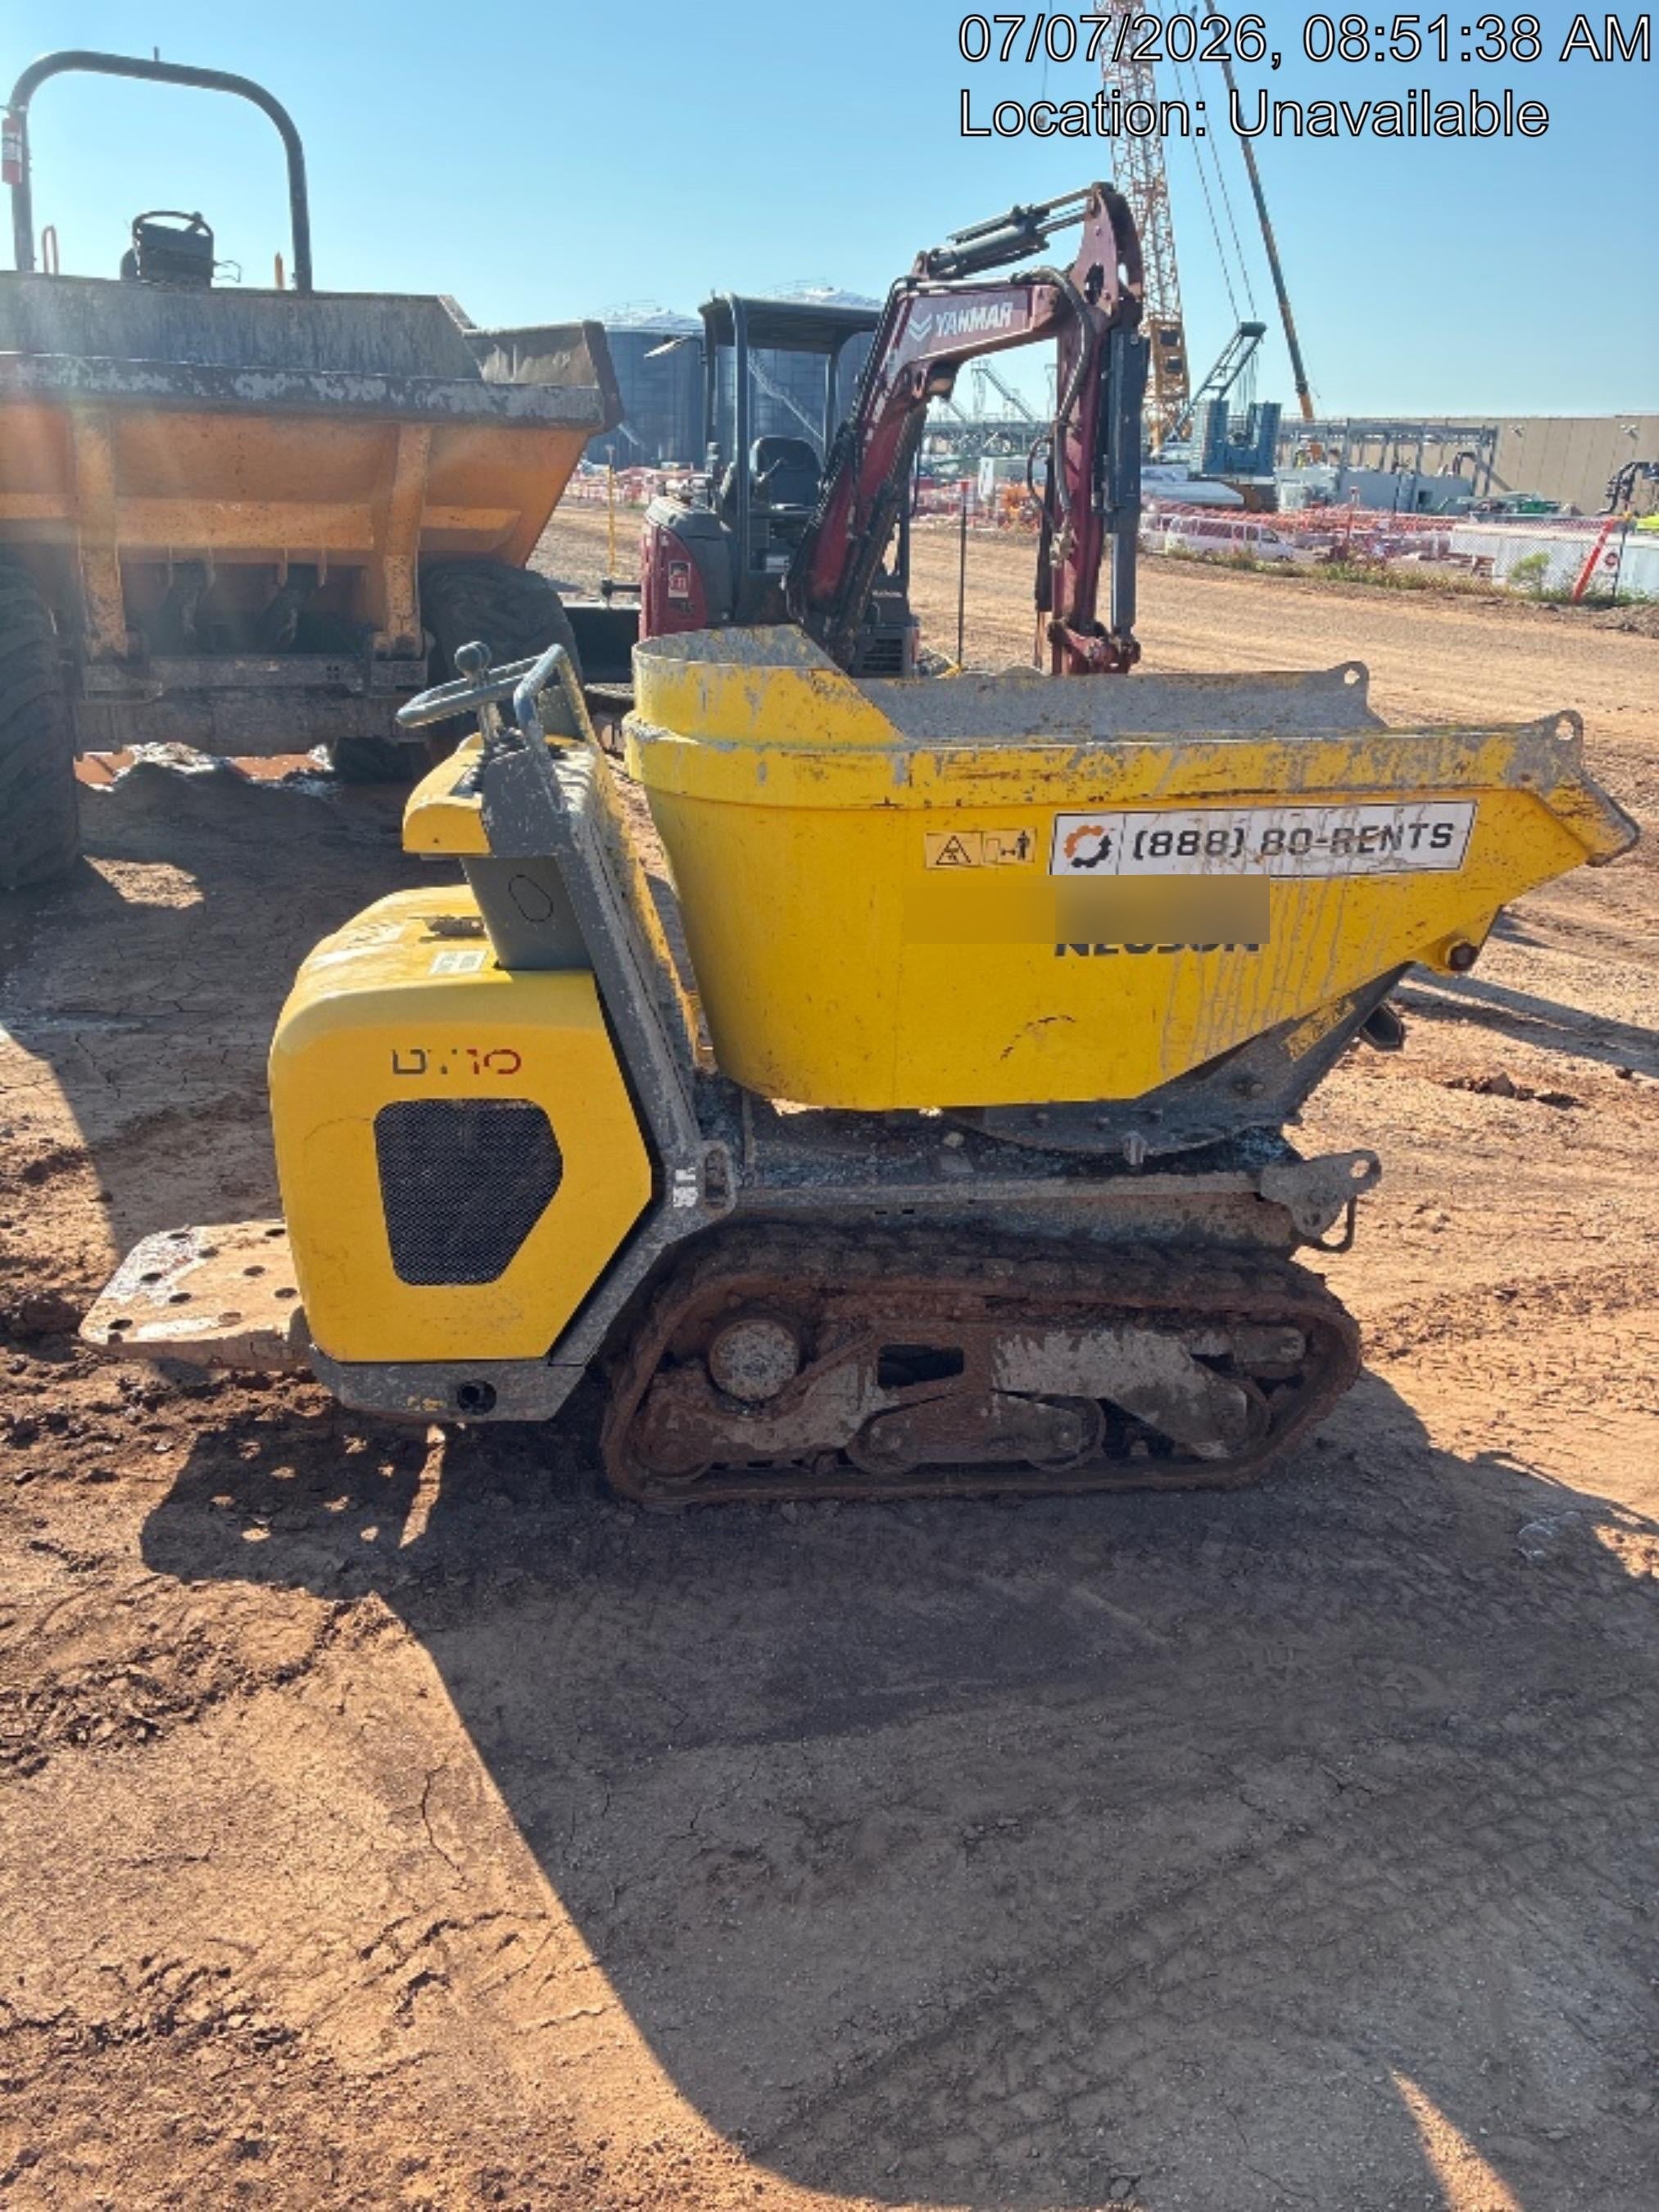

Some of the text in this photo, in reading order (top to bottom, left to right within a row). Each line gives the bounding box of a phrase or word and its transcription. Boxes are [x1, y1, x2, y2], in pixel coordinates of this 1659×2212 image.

[936, 301, 1013, 337] YANMAR
[1134, 823, 1455, 860] (888) 80-RENTS
